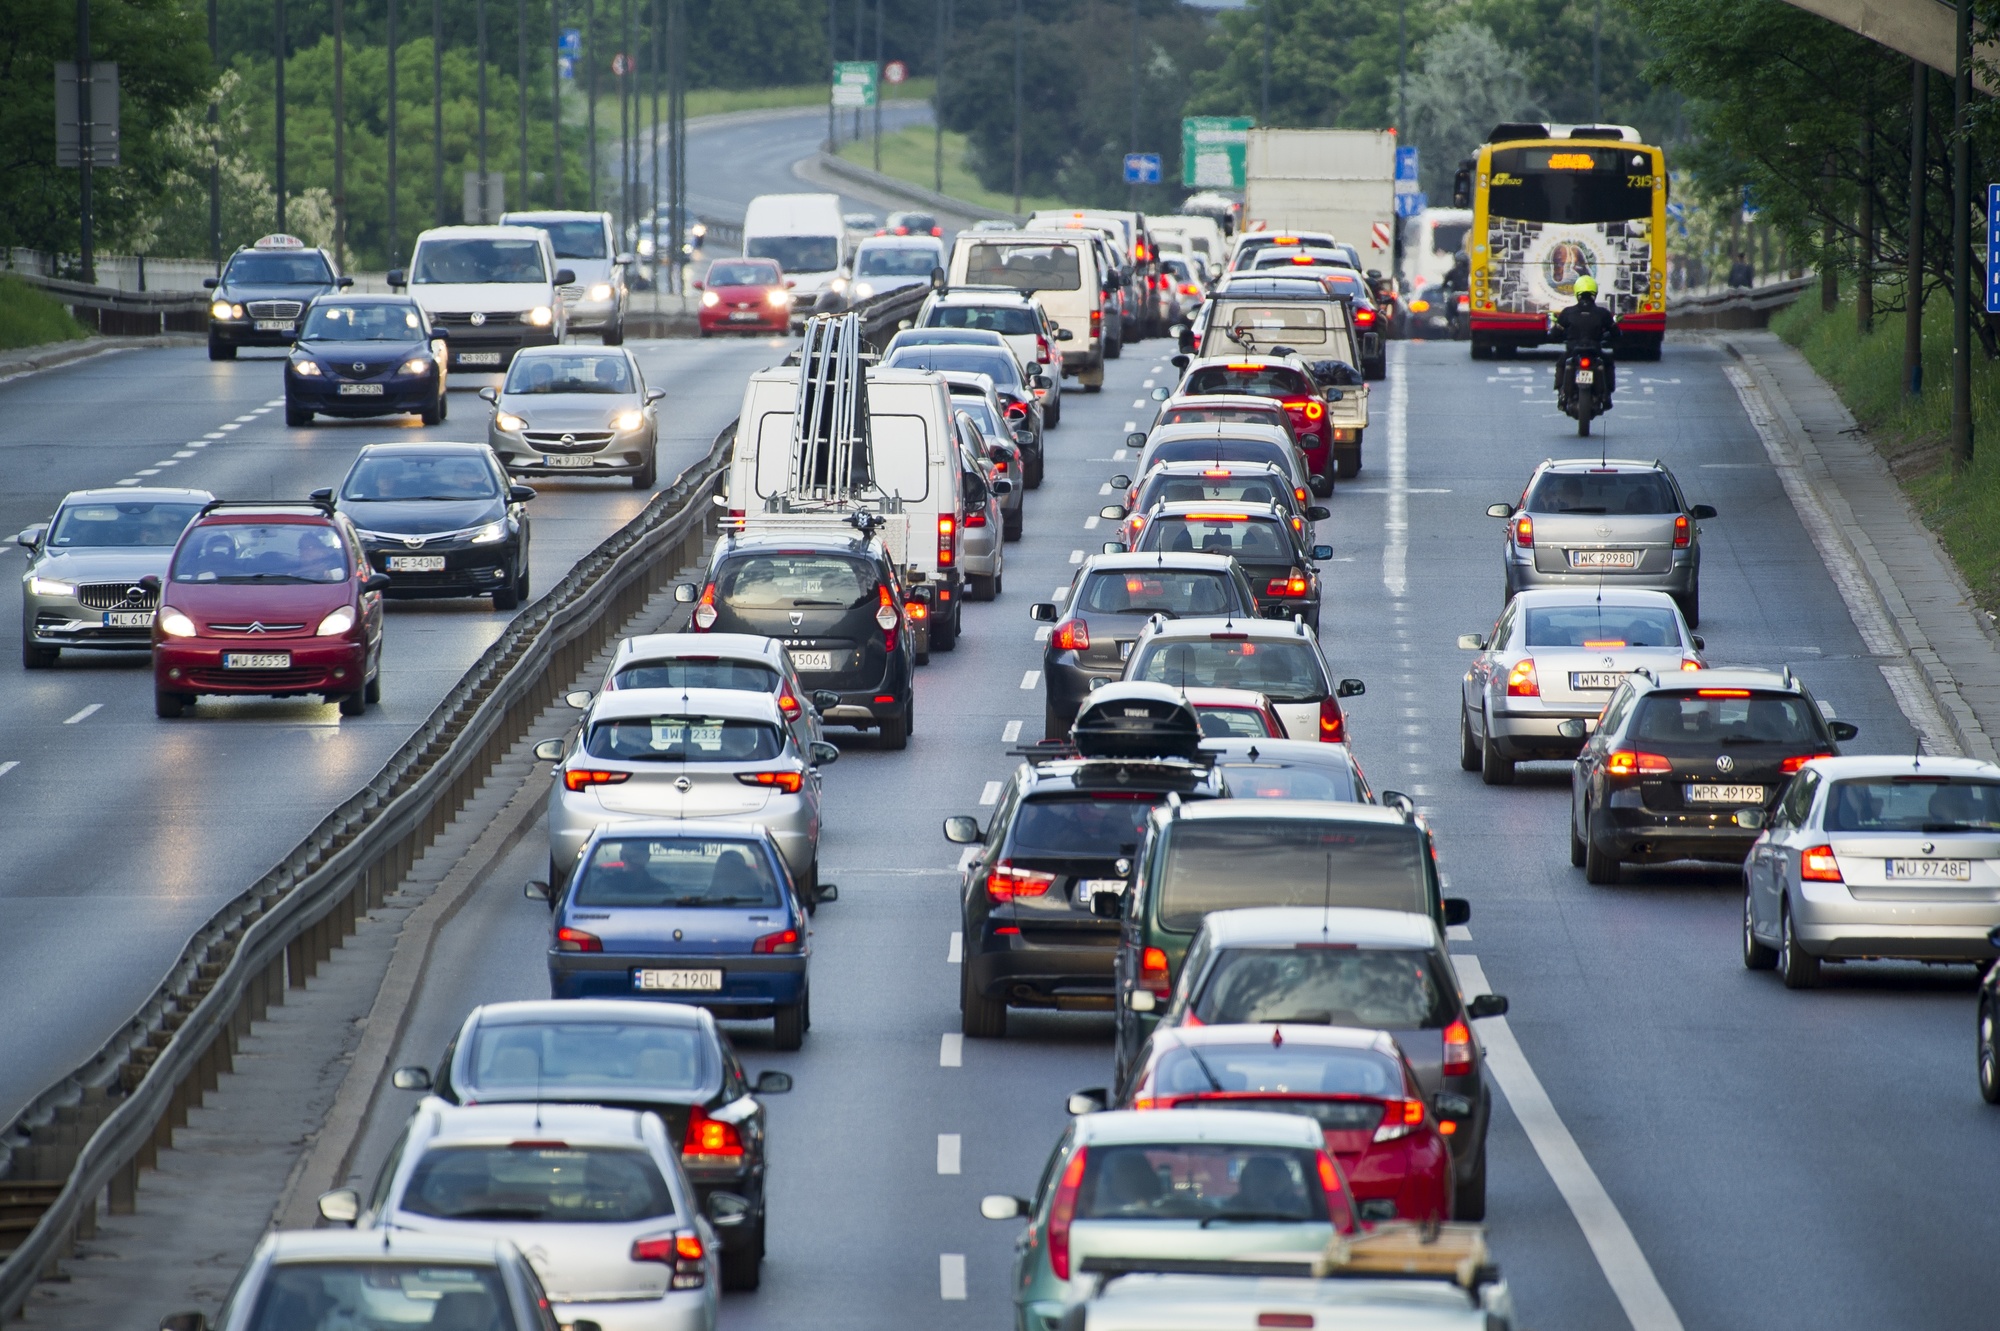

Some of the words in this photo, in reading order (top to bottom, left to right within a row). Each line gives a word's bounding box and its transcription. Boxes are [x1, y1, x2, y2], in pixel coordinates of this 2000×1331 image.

[273, 236, 285, 244] TAXI
[549, 456, 562, 465] DW
[565, 456, 592, 466] 91709
[393, 557, 407, 568] WE
[411, 557, 443, 568] 343NR
[1581, 553, 1595, 563] WK
[1600, 553, 1633, 563] 29980
[111, 614, 126, 625] WL
[131, 614, 151, 625] 617
[231, 655, 248, 667] WU
[1581, 674, 1599, 686] WM
[1694, 786, 1718, 799] WPR
[1723, 786, 1762, 800] 49195
[1895, 861, 1917, 876] WU
[1922, 861, 1968, 877] 9748F
[644, 972, 664, 987] EL
[672, 972, 717, 988] 2190L
